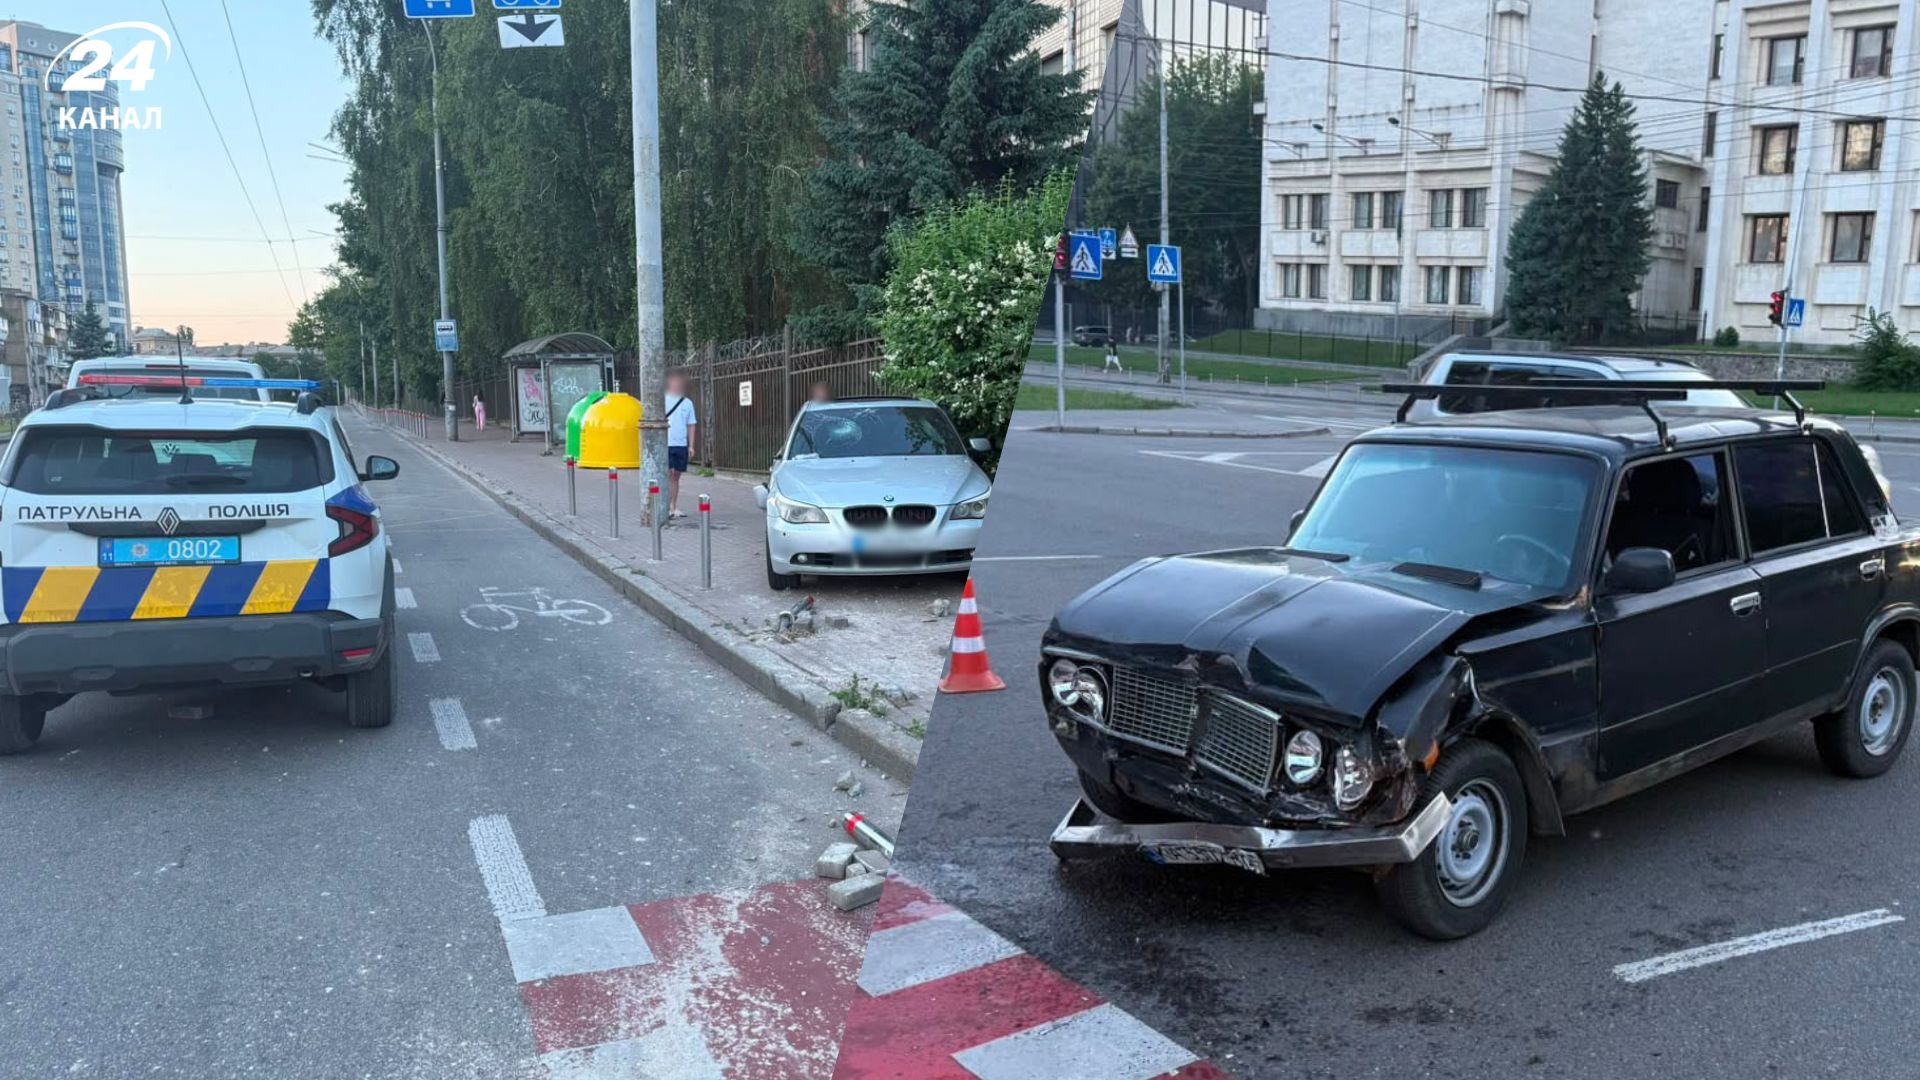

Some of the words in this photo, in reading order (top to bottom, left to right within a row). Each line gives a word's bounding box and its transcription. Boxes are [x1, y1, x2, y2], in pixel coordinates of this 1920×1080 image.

[18, 506, 142, 519] ПАТРУЛЬНА
[208, 503, 290, 518] ПОЛІЦІЯ
[168, 540, 221, 558] 0802
